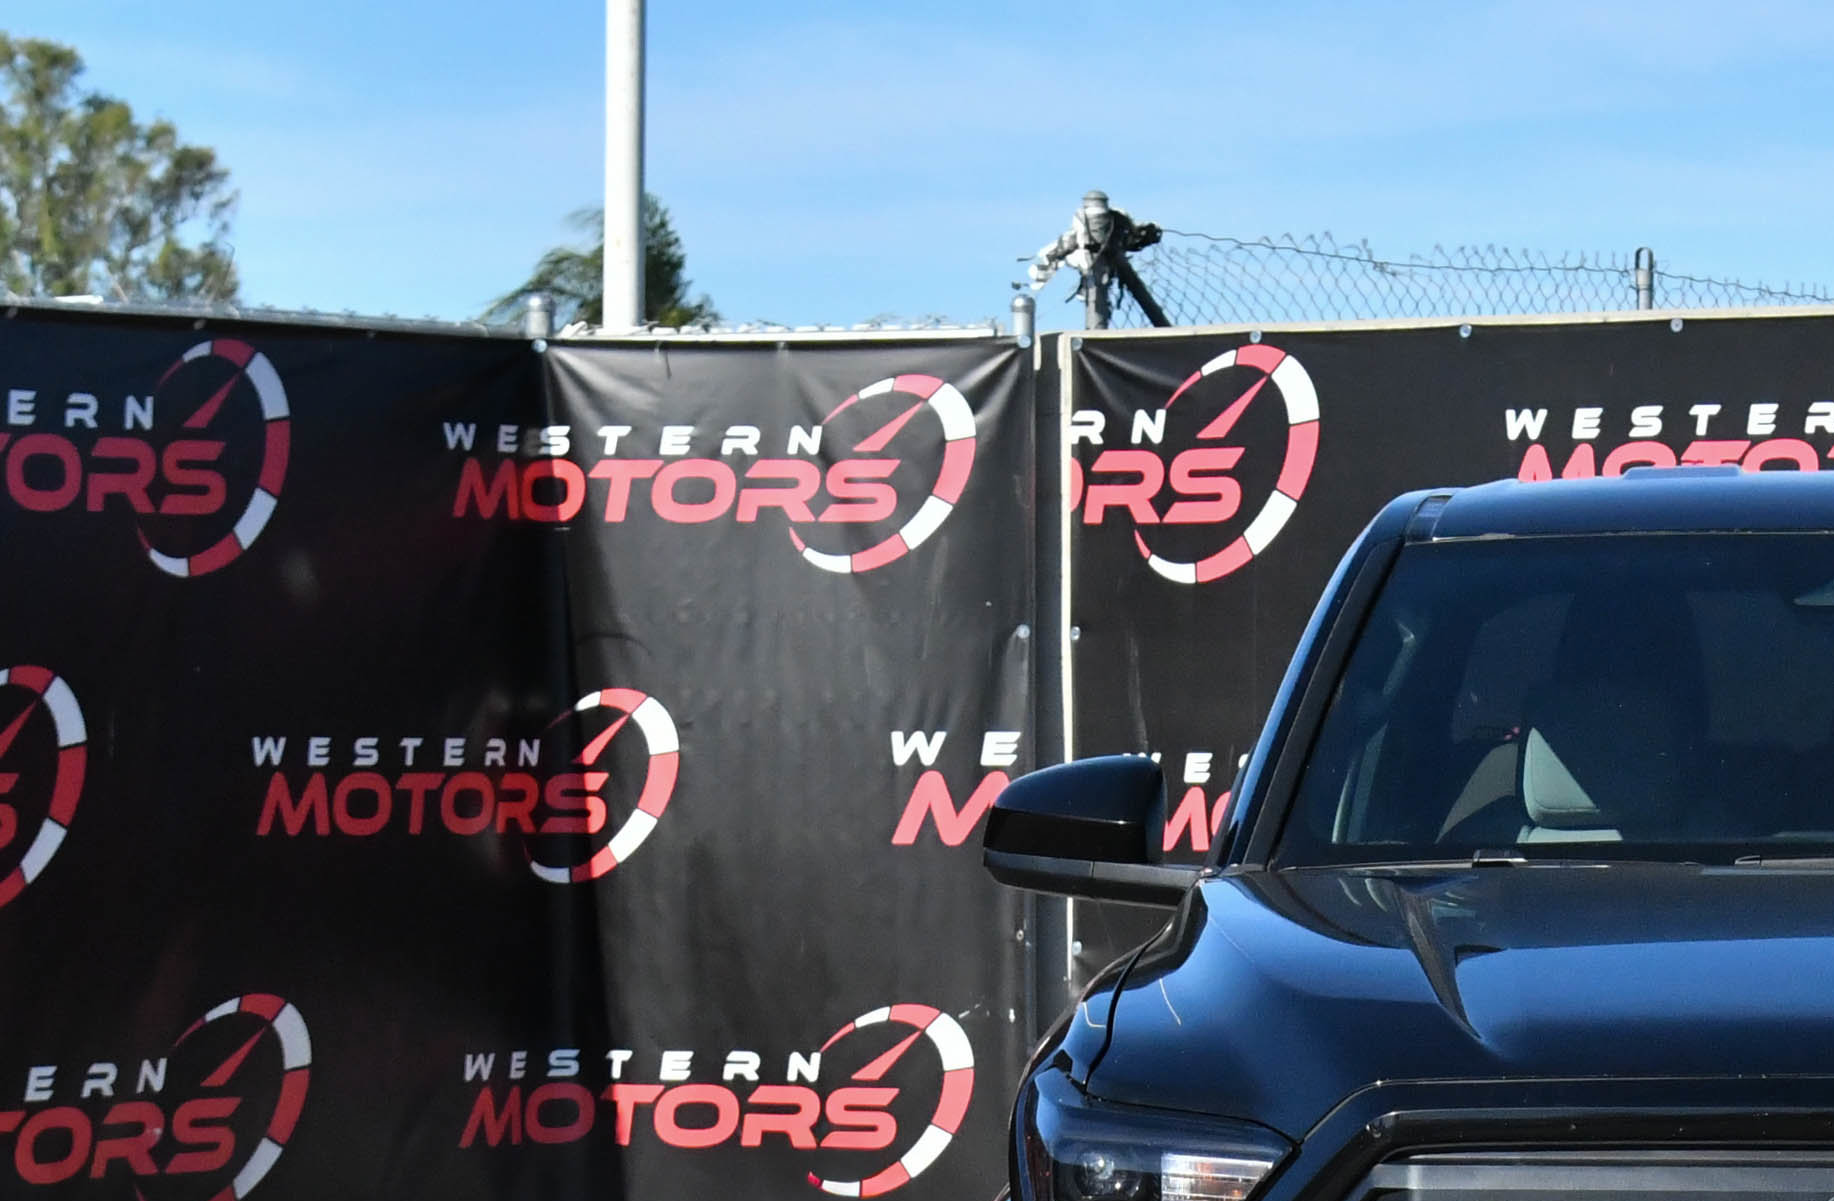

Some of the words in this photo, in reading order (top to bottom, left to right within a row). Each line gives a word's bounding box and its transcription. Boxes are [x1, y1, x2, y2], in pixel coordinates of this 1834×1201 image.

[442, 421, 823, 456] WESTERN
[0, 432, 227, 515] ORS
[452, 458, 901, 523] MOTORS
[252, 736, 541, 767] WESTERN
[256, 771, 609, 837] MOTORS
[463, 1049, 823, 1083] WESTERN
[0, 1096, 243, 1185] ORS
[458, 1082, 900, 1150] MOTORS
